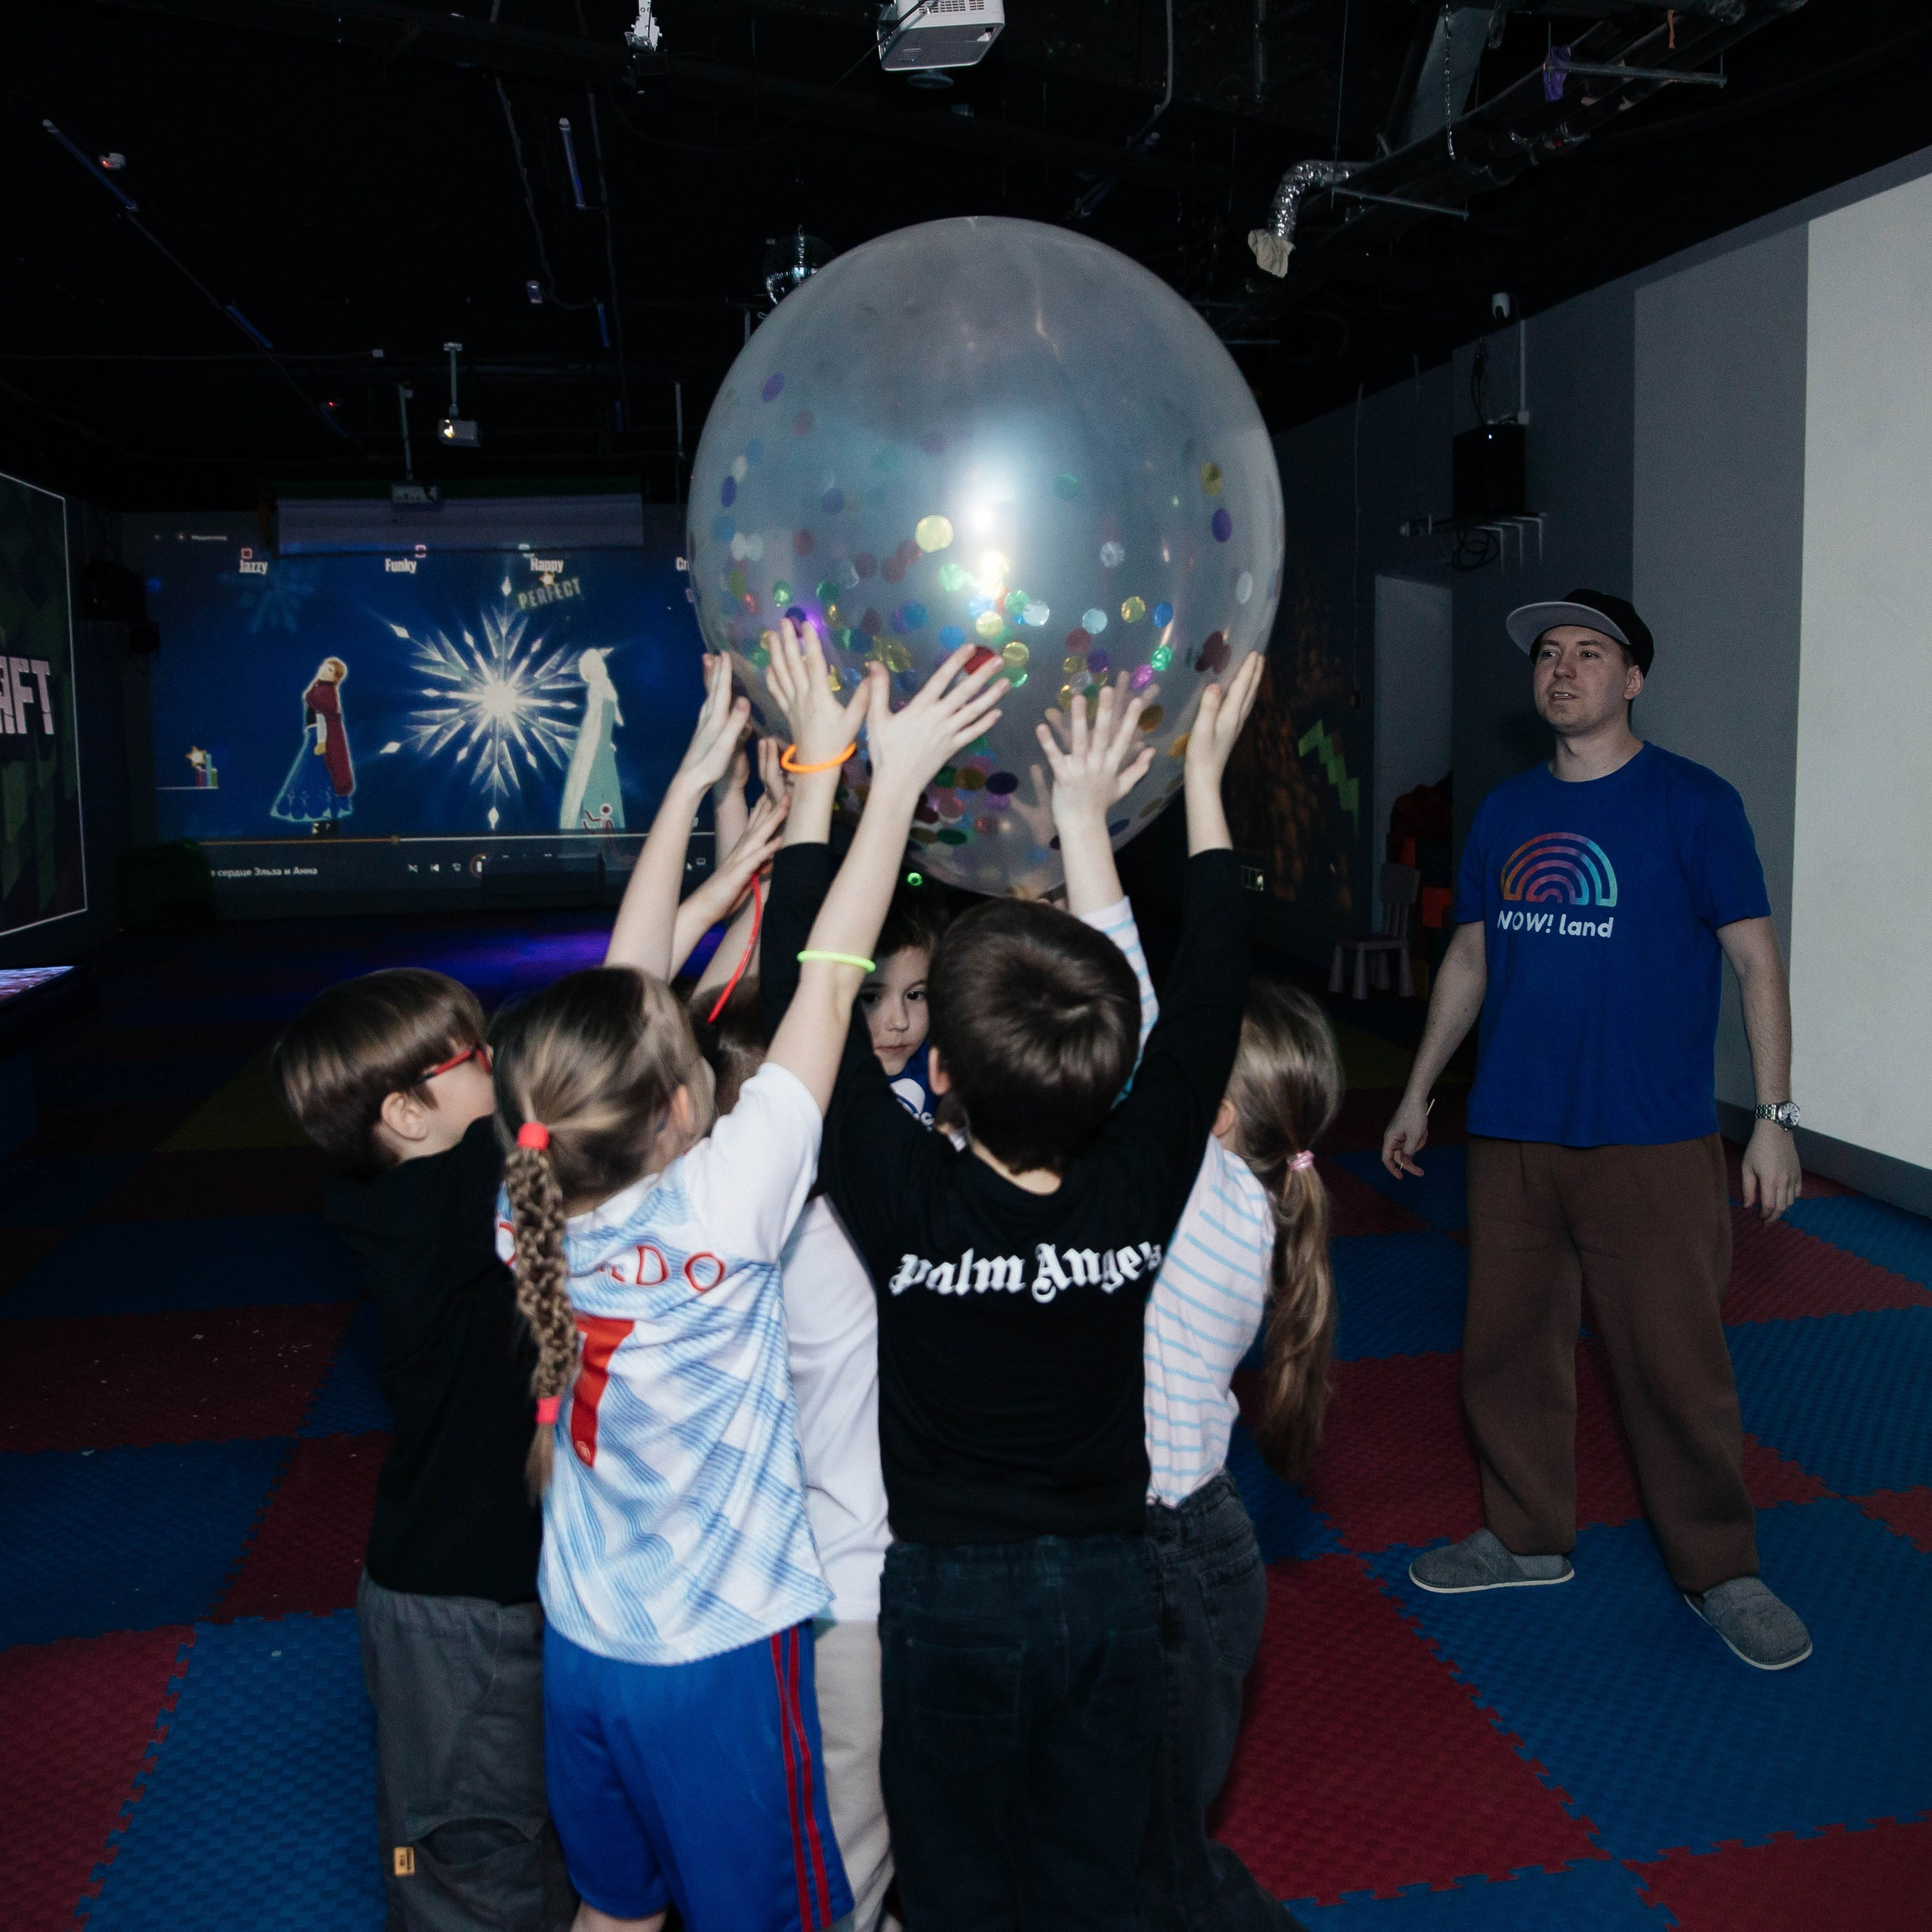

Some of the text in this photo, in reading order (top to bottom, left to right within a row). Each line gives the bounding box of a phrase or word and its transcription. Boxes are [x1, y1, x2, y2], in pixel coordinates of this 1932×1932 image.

[385, 558, 417, 574] Funky
[217, 869, 252, 878] сердце
[254, 867, 282, 876] Эльза
[293, 866, 318, 875] Анна
[1497, 910, 1614, 938] NOW! land
